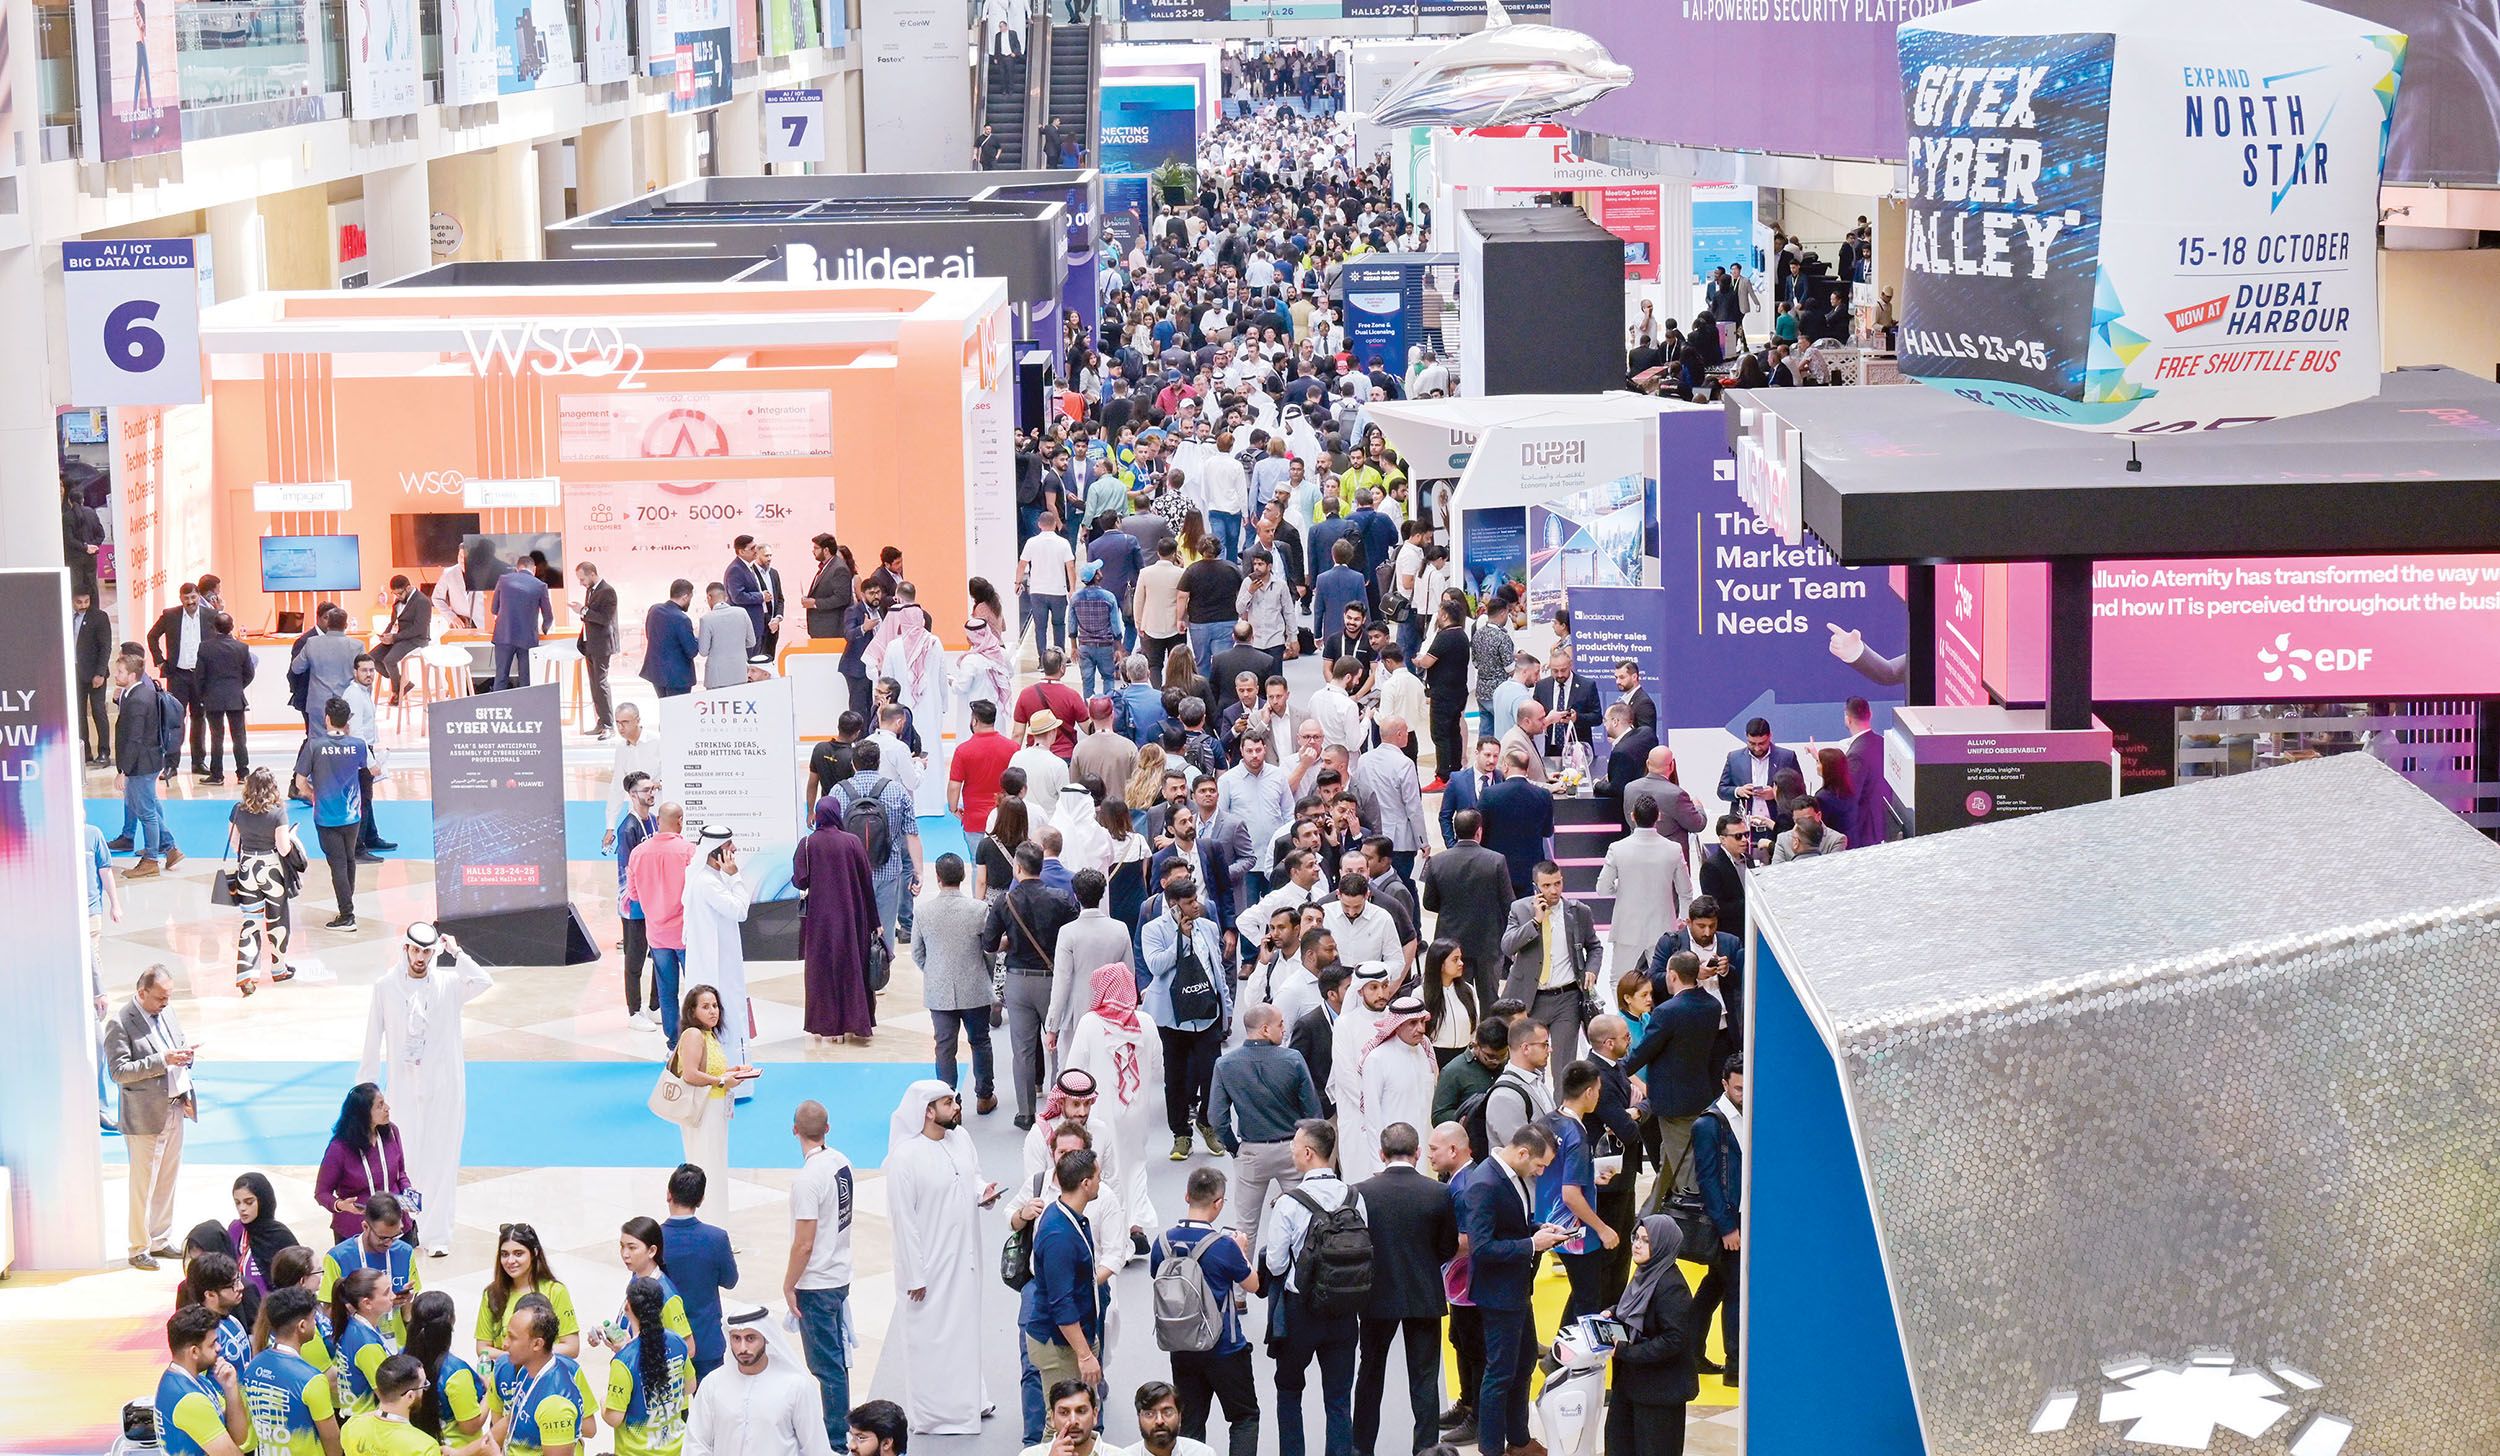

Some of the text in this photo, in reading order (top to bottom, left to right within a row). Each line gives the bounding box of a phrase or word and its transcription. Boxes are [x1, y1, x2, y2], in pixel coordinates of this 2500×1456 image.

[1176, 9, 1205, 18] 23-25
[1351, 8, 1380, 16] HALLS
[1692, 0, 1951, 22] AI-POWERED SECURITY PLATFORM
[2184, 66, 2250, 88] EXPAND
[1913, 65, 2050, 129] GITEX
[2185, 95, 2306, 137] NORTH
[782, 116, 808, 147] 7
[1101, 126, 1149, 136] NECTING
[1908, 136, 2042, 205] CYBER
[2243, 142, 2328, 187] STAR
[1553, 167, 1607, 181] imagine.
[1605, 189, 1630, 197] Meeting
[104, 244, 152, 256] AI IOT
[2178, 232, 2349, 266] 15-18 OCTOBER
[70, 256, 188, 268] BIG DATA CLOUD
[786, 243, 975, 282] Builder.ai
[2235, 281, 2322, 308] DUBAI
[2175, 301, 2221, 330] NOW AT
[2227, 307, 2349, 336] HARBOUR
[104, 300, 166, 372] 6
[1903, 327, 2047, 372] HALLS 23-25
[2154, 349, 2341, 380] FREE SHUTTLLE BUS
[560, 409, 609, 420] anagement
[757, 406, 806, 415] Integration
[400, 470, 464, 496] WSO
[1521, 482, 1548, 490] Economy
[636, 504, 793, 521] 700+ 5000+ 25k+
[1715, 512, 1768, 536] The
[131, 546, 150, 570] Digita
[1716, 544, 1862, 570] Marketi
[2152, 568, 2233, 592] Aternity
[2236, 566, 2272, 586] has
[2274, 564, 2398, 585] transformed
[2401, 564, 2434, 584] the
[2437, 567, 2478, 586] way
[1715, 577, 1866, 602] Your Team
[2092, 592, 2500, 619] nd how IT is perceived throughout the busi
[1717, 610, 1808, 634] Needs
[1576, 630, 1647, 641] Get higher sales
[1576, 642, 1652, 653] productivity from
[1576, 654, 1639, 664] all your teams
[0, 690, 36, 712] LY
[694, 700, 758, 716] GITEX
[475, 708, 513, 720] GITEX
[446, 721, 542, 734] CYBER VALLEY
[321, 746, 357, 755] ASK ME
[734, 741, 760, 749] IDEAS,
[744, 748, 767, 756] TALKS
[1994, 746, 2046, 754] OBSERVABILITY
[2126, 744, 2148, 752] with
[2122, 768, 2167, 777] Solutions
[466, 867, 535, 875] HALLS 23-24-25
[543, 1420, 574, 1430] GITEX
